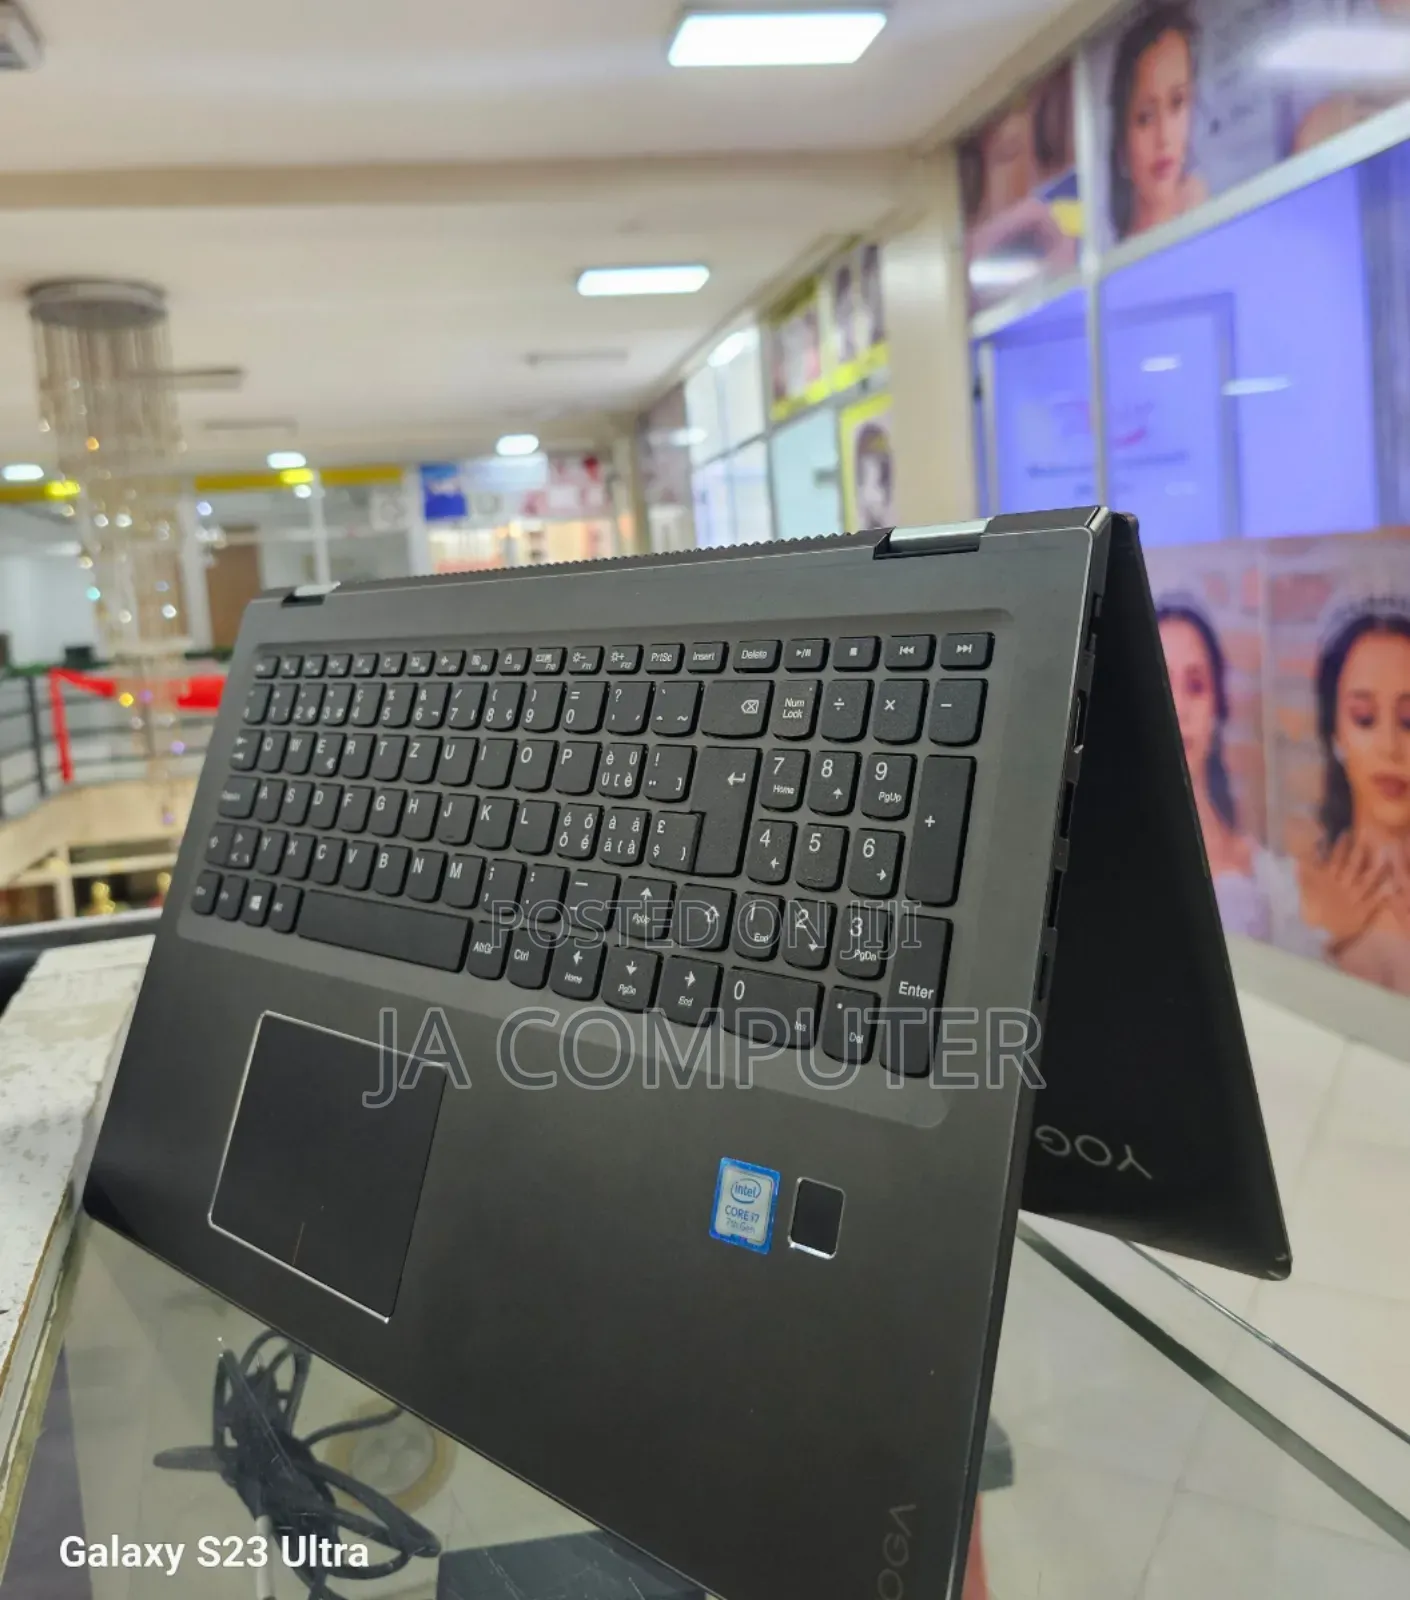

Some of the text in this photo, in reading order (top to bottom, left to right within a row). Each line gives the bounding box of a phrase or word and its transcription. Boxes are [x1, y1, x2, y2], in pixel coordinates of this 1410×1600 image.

[651, 652, 672, 662] PrtSc
[692, 652, 715, 661] Insert
[741, 649, 768, 660] Delete
[784, 698, 804, 708] Num
[486, 708, 495, 722] 8
[526, 709, 534, 724] 9
[782, 709, 803, 719] Lock
[316, 738, 327, 754] E
[380, 742, 388, 756] T
[409, 743, 420, 758] Z
[444, 744, 455, 760] U
[521, 747, 532, 763] O
[561, 749, 572, 764] P
[773, 757, 785, 776] 7
[820, 759, 834, 778] 8
[874, 762, 888, 781] 9
[284, 788, 296, 803] S
[313, 790, 324, 805] D
[772, 784, 795, 796] Home
[878, 792, 902, 804] PgUp
[344, 793, 354, 808] F
[376, 796, 386, 811] G
[408, 798, 419, 814] H
[443, 802, 454, 818] J
[480, 804, 492, 821] K
[520, 808, 529, 825] L
[759, 829, 772, 848] 4
[809, 833, 822, 852] 5
[318, 844, 328, 860] C
[348, 848, 358, 864] V
[862, 838, 876, 858] 6
[378, 852, 389, 868] B
[412, 858, 424, 874] N
[450, 862, 463, 880] M
[795, 908, 809, 930] 2
[850, 917, 864, 938] 3
[513, 948, 530, 961] Ctrl
[854, 949, 877, 962] PgDn
[734, 980, 746, 1000] 0
[898, 980, 934, 1000] Enter
[734, 1182, 757, 1198] intel
[724, 1204, 760, 1224] CORE i7
